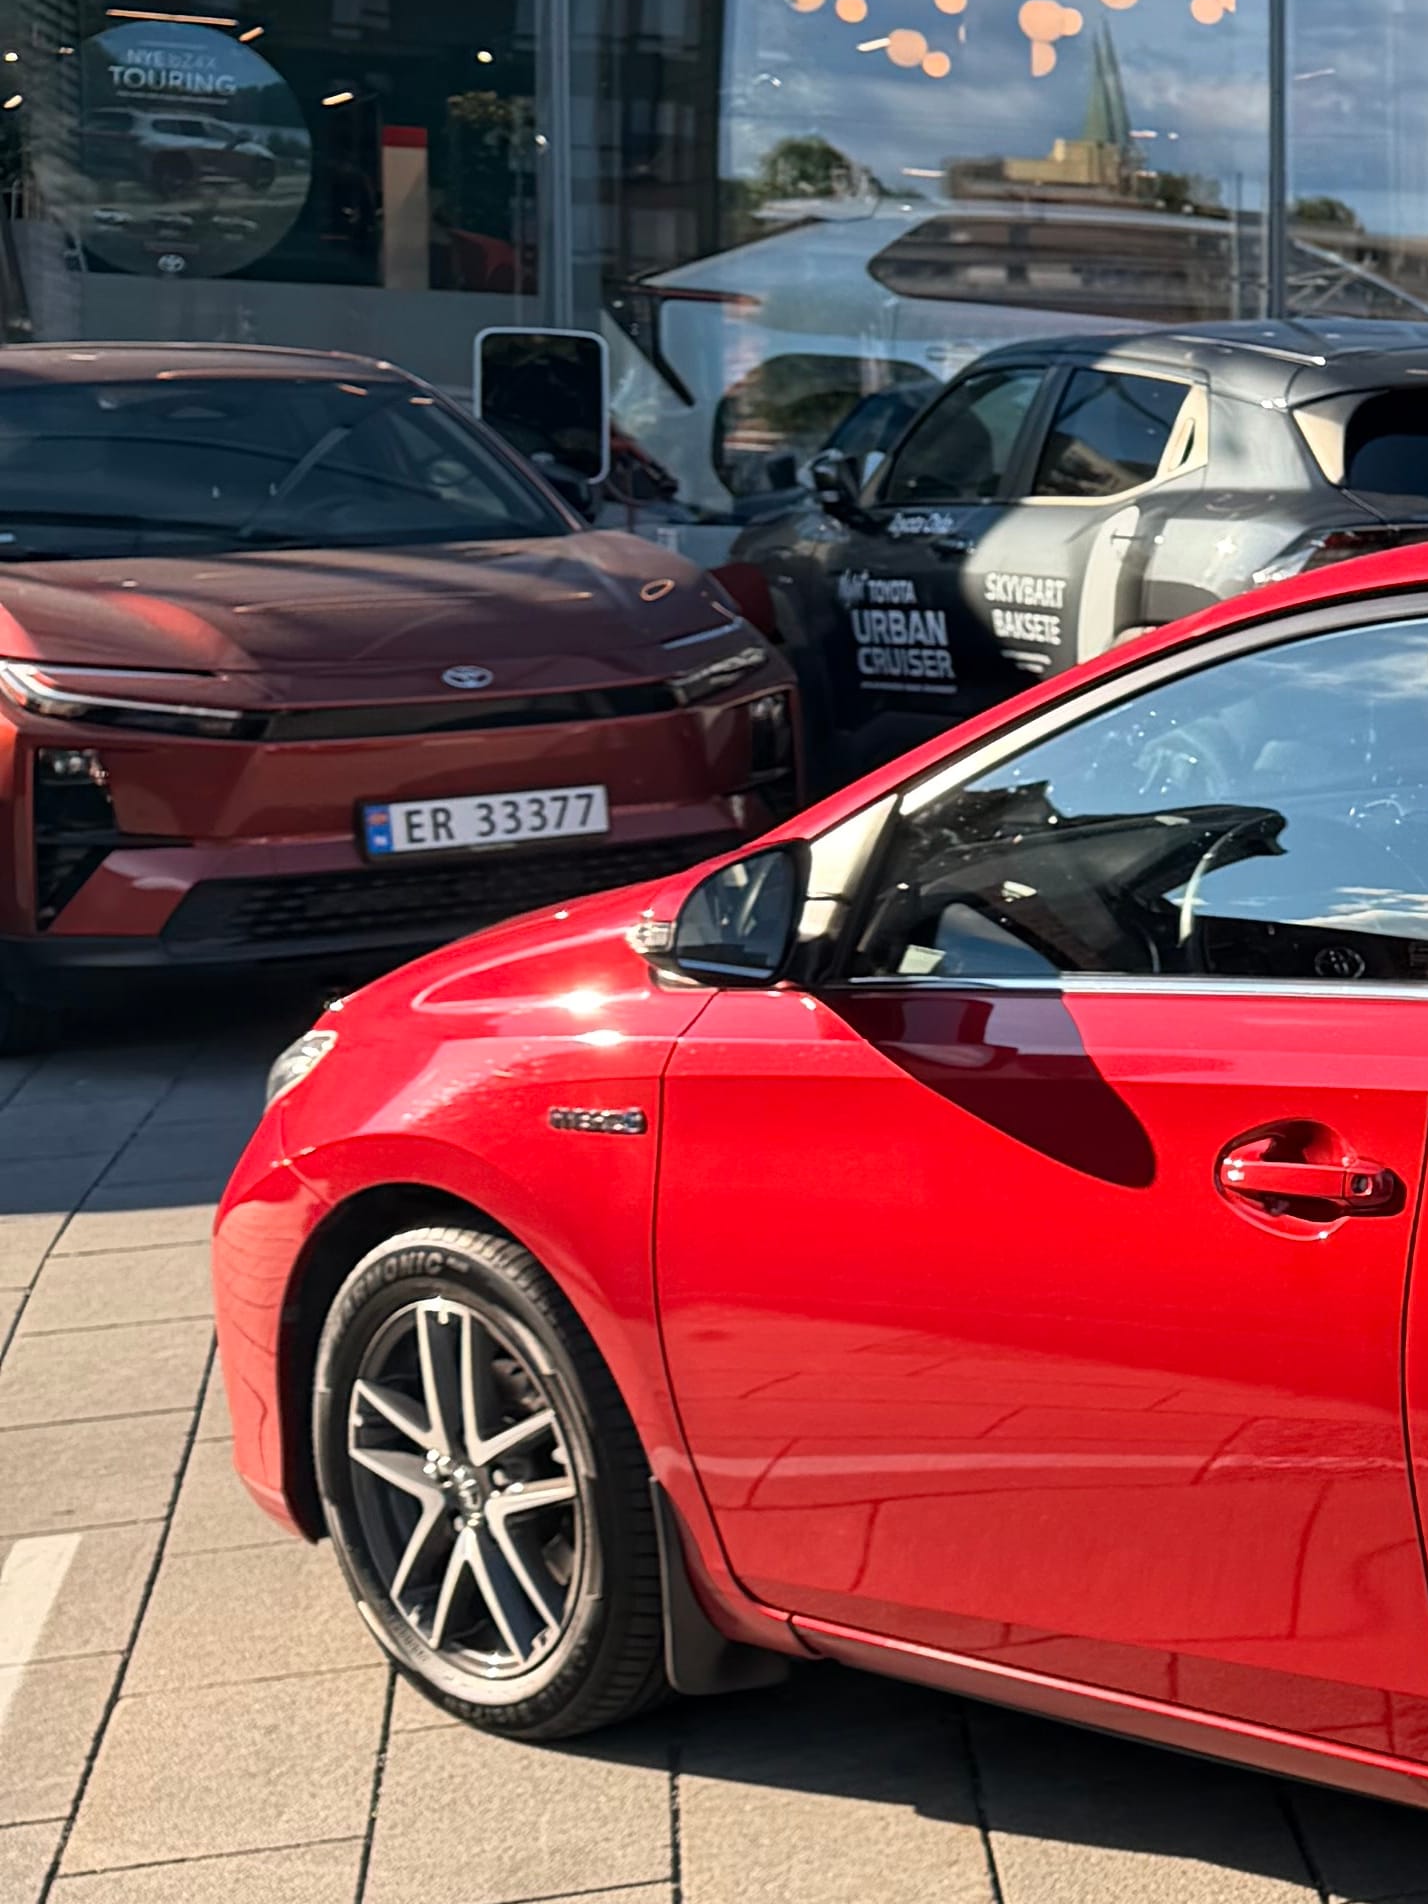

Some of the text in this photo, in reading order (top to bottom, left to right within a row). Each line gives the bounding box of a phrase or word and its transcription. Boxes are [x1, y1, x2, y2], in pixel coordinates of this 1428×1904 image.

[127, 47, 165, 67] NYE
[108, 64, 238, 96] TOURING
[867, 578, 918, 604] TOYOTA
[851, 608, 949, 647] URBAN
[856, 647, 956, 679] CRUISER
[404, 793, 595, 844] ER 33377
